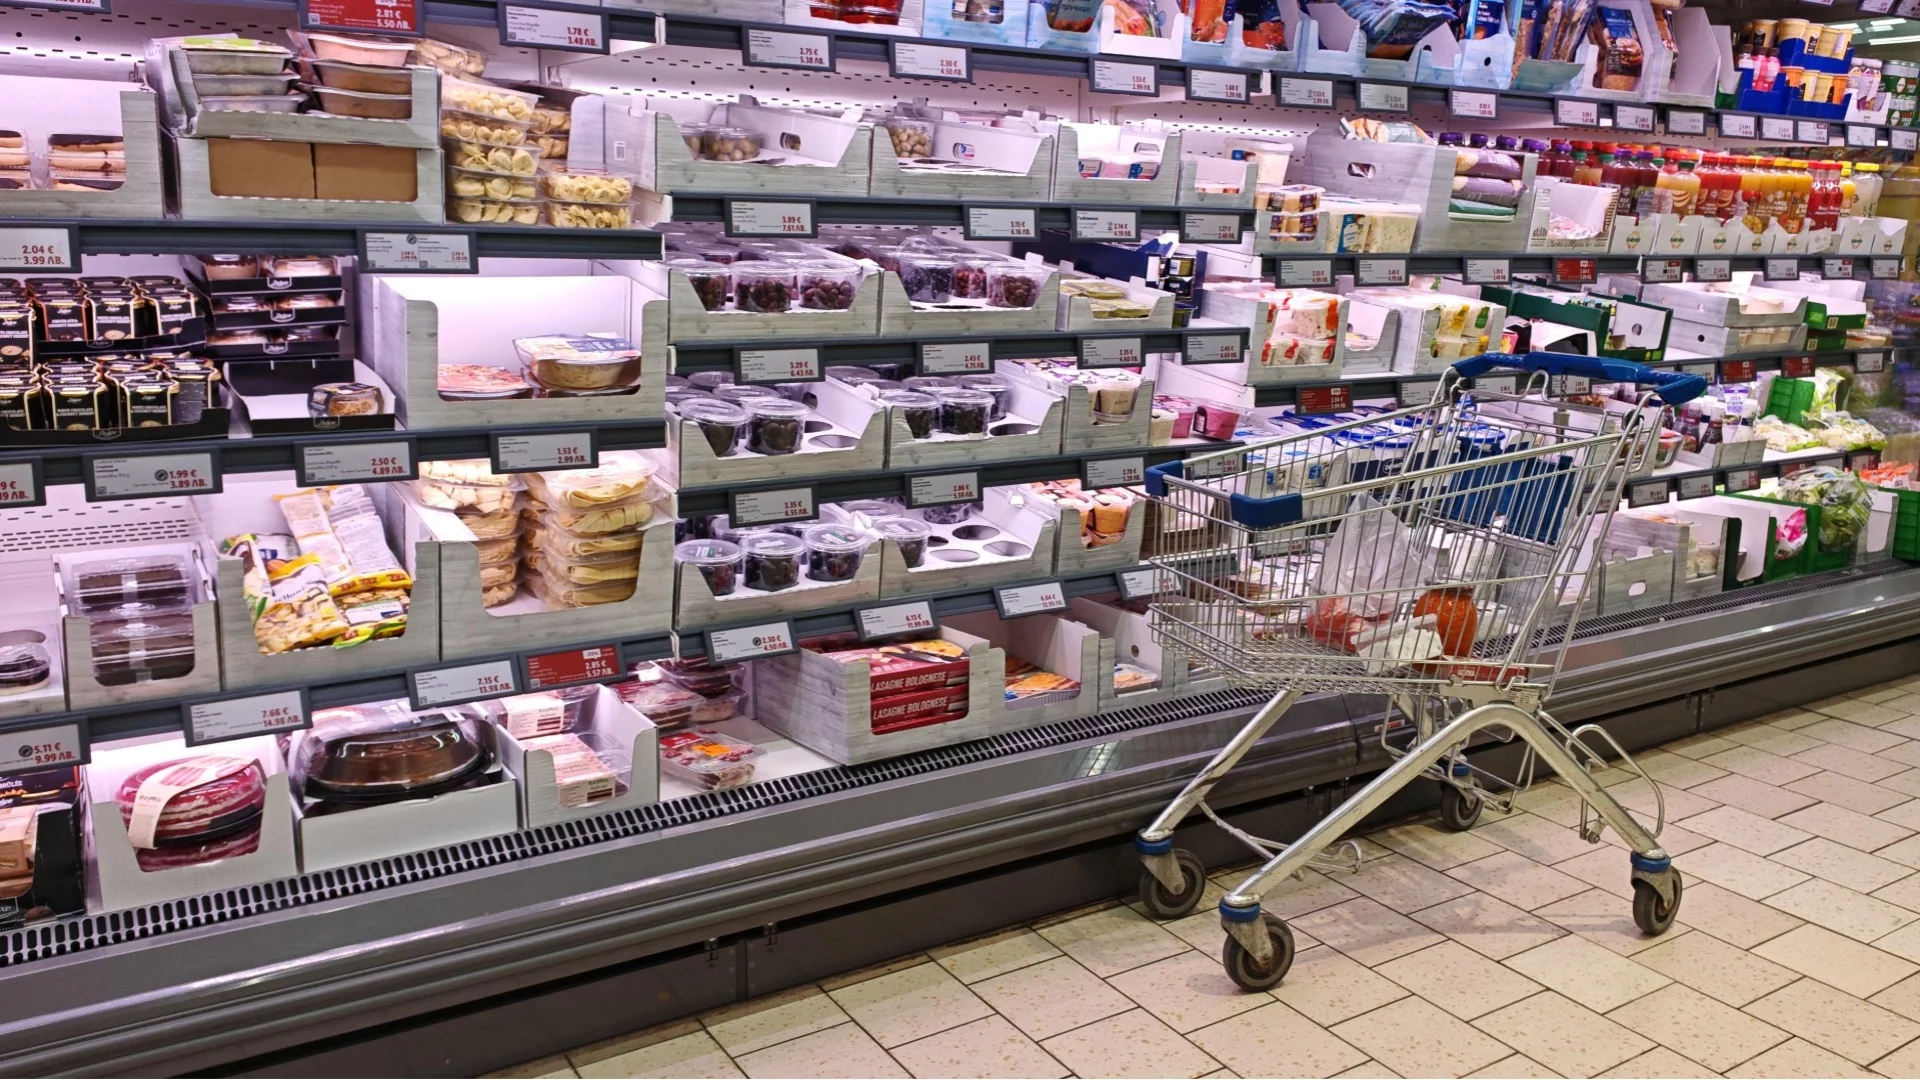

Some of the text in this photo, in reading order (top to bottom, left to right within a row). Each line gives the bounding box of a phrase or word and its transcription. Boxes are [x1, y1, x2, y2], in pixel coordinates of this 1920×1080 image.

[376, 9, 402, 18] 2.81 €
[376, 19, 395, 28] 5.50
[567, 27, 581, 36] 1.78
[567, 36, 584, 45] 3.48
[22, 246, 54, 254] 2.04 €
[23, 256, 45, 264] 3.99
[372, 458, 389, 466] 2.50
[169, 470, 189, 479] 1.99
[372, 467, 390, 475] 4.89
[10, 481, 16, 489] €
[170, 480, 190, 488] 3.89
[762, 636, 776, 645] 2.30
[585, 661, 600, 670] 2.85
[586, 669, 600, 678] 5.57
[479, 676, 492, 685] 7.15
[871, 671, 947, 692] LASAGNE BOLOGNESE
[480, 685, 498, 693] 13.98
[873, 696, 948, 720] LASAGNE BOLOGNESE
[262, 707, 290, 719] 7.66 €
[263, 717, 285, 727] 14.98
[34, 742, 61, 754] 5.11 €
[36, 754, 56, 764] 9.99
